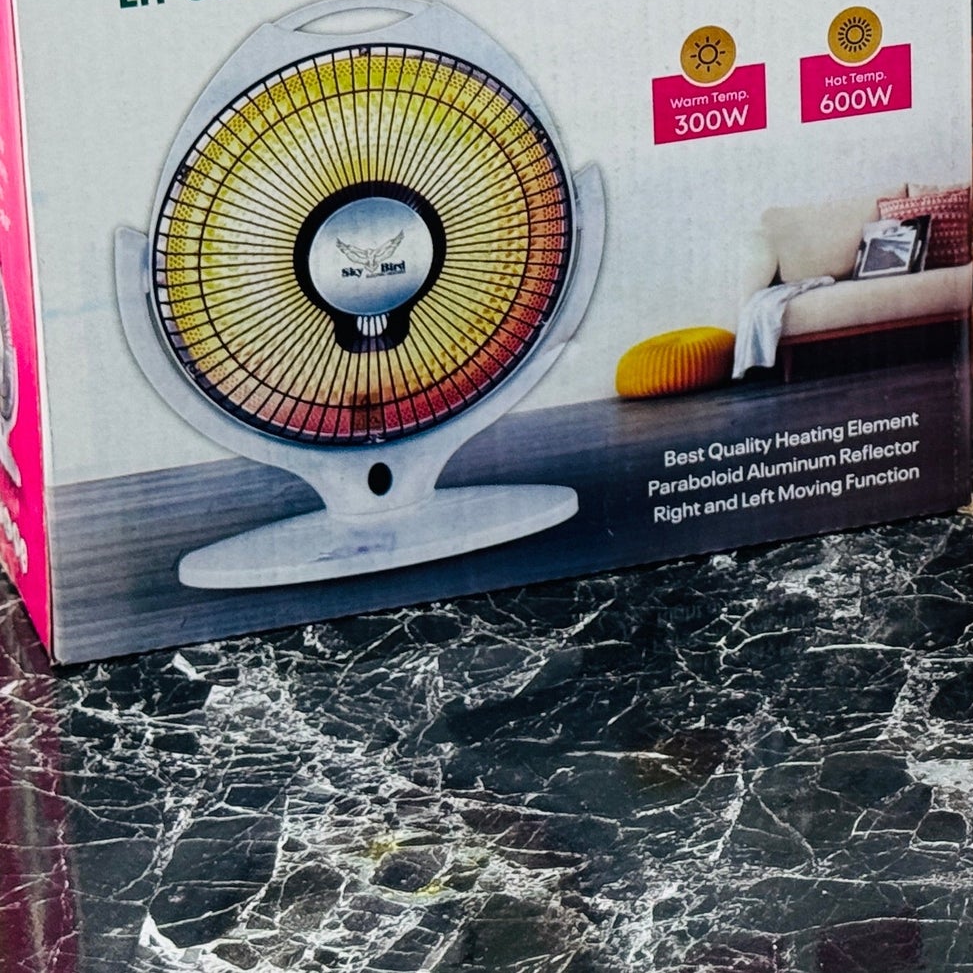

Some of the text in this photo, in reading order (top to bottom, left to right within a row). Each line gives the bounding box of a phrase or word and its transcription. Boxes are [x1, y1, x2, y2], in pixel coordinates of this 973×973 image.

[825, 70, 887, 87] Hot Temp.
[670, 89, 750, 109] Warm Temp.
[820, 84, 893, 114] 600W
[674, 104, 749, 135] 300W
[341, 267, 363, 278] Sky
[381, 260, 406, 272] Bird
[664, 412, 919, 468] Best Quality Heating Element
[648, 438, 920, 497] Paraboloid Aluminum Reflector
[653, 464, 920, 525] Right and Left Moving Function
